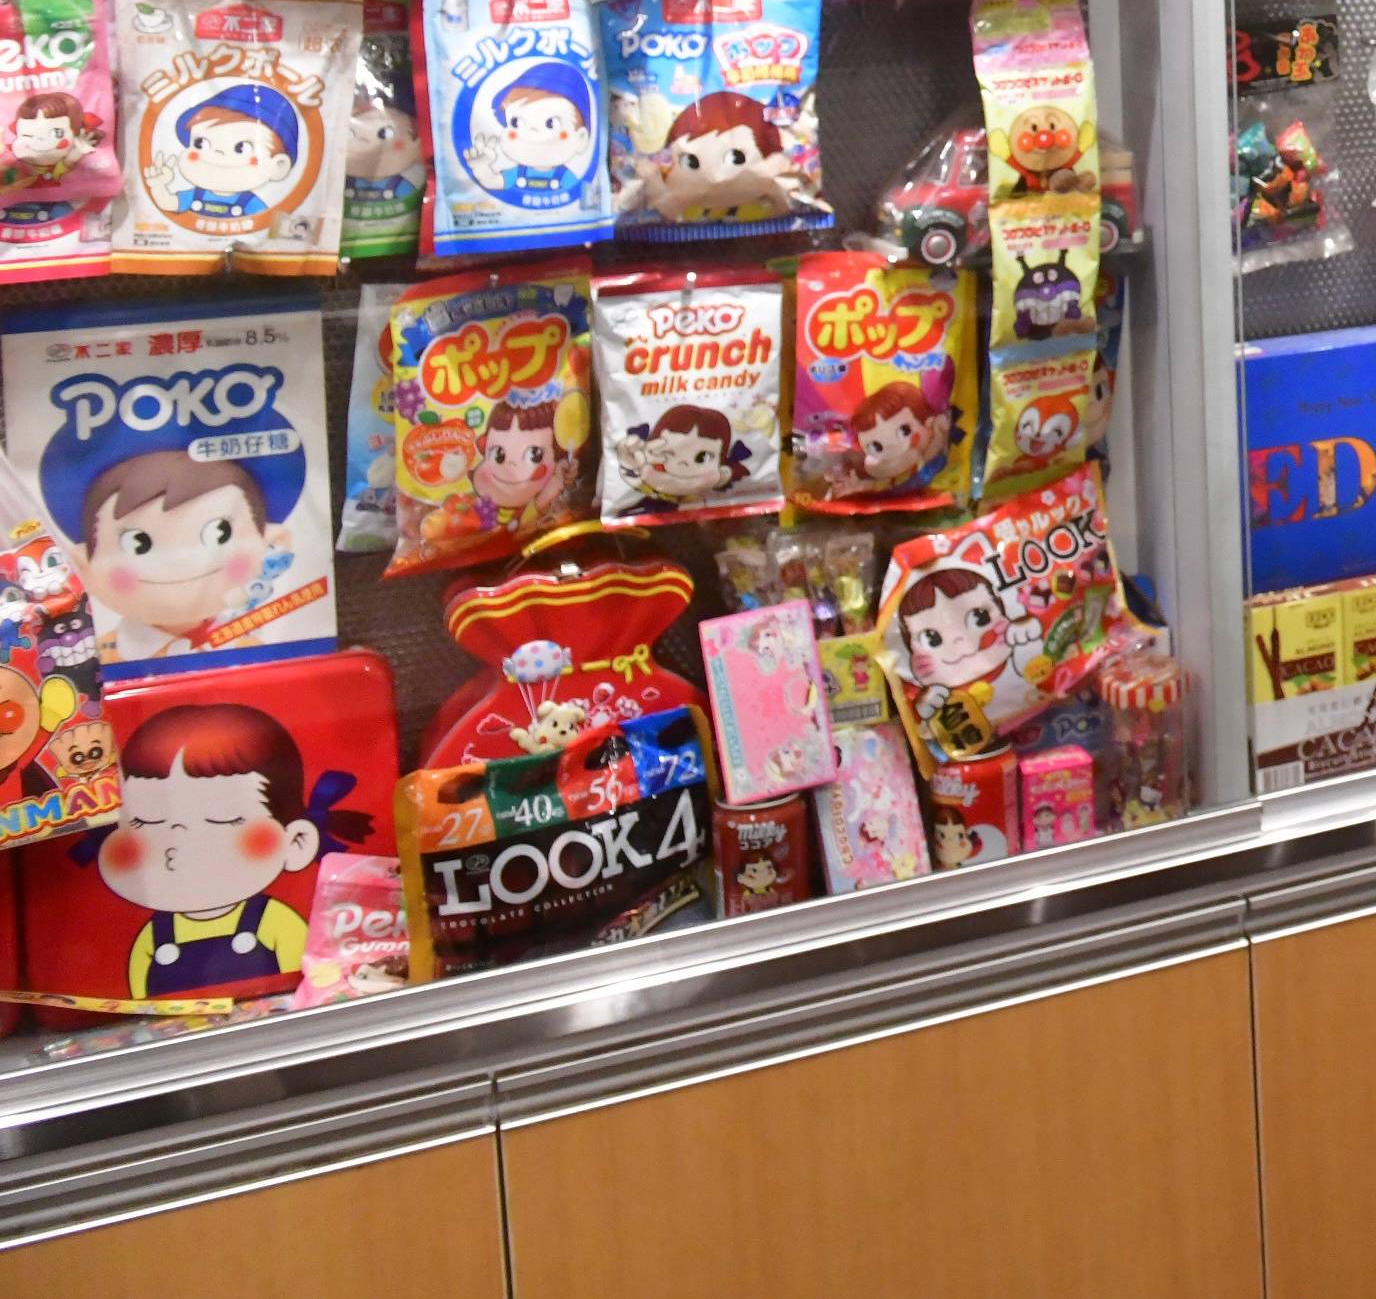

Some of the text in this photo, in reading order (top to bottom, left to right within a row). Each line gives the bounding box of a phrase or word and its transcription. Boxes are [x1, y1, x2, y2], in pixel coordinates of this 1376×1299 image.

[815, 297, 951, 357] ポップ
[429, 324, 562, 397] ポップ
[624, 332, 773, 375] crunch
[640, 367, 762, 398] milk candy
[59, 367, 277, 442] POKO
[196, 432, 290, 459] 牛奶仔糖
[986, 509, 1107, 591] LOOK
[1281, 656, 1335, 676] CACAO
[440, 808, 484, 847] 27
[514, 793, 552, 826] 40
[433, 810, 653, 917] LOOK
